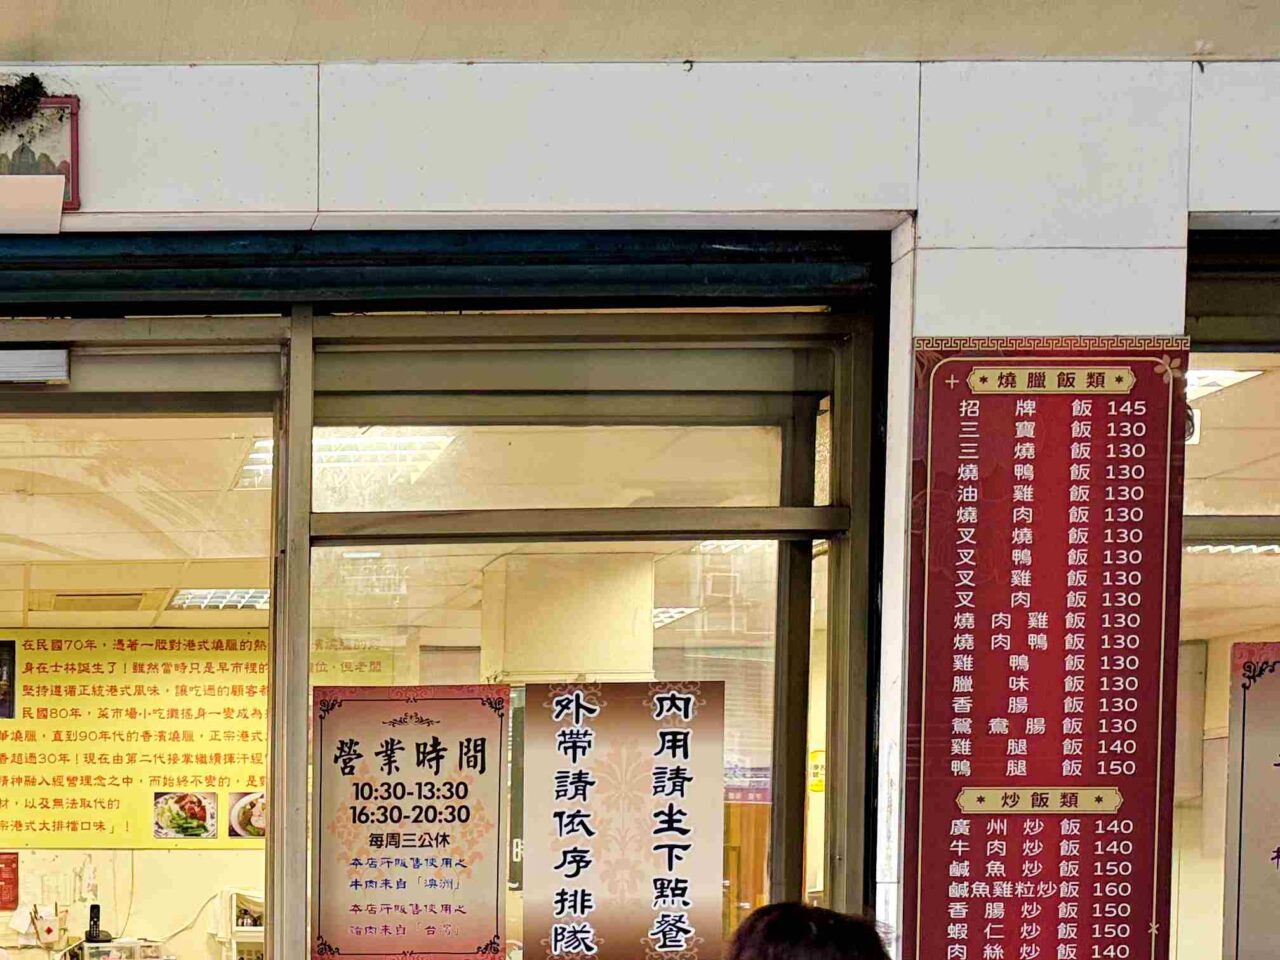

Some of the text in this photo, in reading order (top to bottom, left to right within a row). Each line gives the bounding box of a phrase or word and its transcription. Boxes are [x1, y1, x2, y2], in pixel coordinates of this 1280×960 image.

[997, 371, 1106, 389] 燒臘飯類
[960, 400, 1146, 416] 招牌飯 145
[959, 421, 1145, 438] 三寶飯 130
[959, 443, 1145, 459] 三燒飯 130
[958, 464, 1144, 480] 燒鴨飯 130
[958, 485, 1143, 501] 油雞飯 130
[957, 506, 1143, 523] 燒肉飯 130
[957, 528, 1142, 544] 叉燒飯 130
[956, 549, 1142, 565] 叉鴨飯 130
[955, 570, 1141, 586] 叉雞飯 130
[955, 591, 1140, 607] 叉肉飯 130
[954, 612, 1140, 629] 燒肉雞飯 130
[954, 633, 1139, 650] 燒肉鴨飯 130
[954, 655, 1139, 671] 雞鴨飯 130
[1101, 677, 1138, 690] 130
[952, 697, 1137, 713] 香腸飯 130
[1100, 719, 1136, 732] 130
[952, 739, 1136, 755] 雞腿飯 140
[333, 736, 487, 776] 營業時間
[951, 760, 1135, 776] 鴨腿飯 150
[352, 782, 468, 801] 10:30-13:30
[1001, 792, 1079, 808] 炒飯類
[350, 805, 470, 824] 16:30-20:30
[553, 691, 598, 953] 外帶請依序排隊
[950, 819, 1133, 835] 廣州炒飯 140
[369, 832, 450, 849] 每周三公休
[950, 840, 1132, 856] 牛肉炒飯 140
[1095, 862, 1131, 875] 150
[1094, 883, 1131, 896] 160
[948, 902, 1130, 918] 香腸炒飯 150
[1093, 924, 1130, 937] 150
[948, 944, 1129, 960] 肉絲炒飯 140
